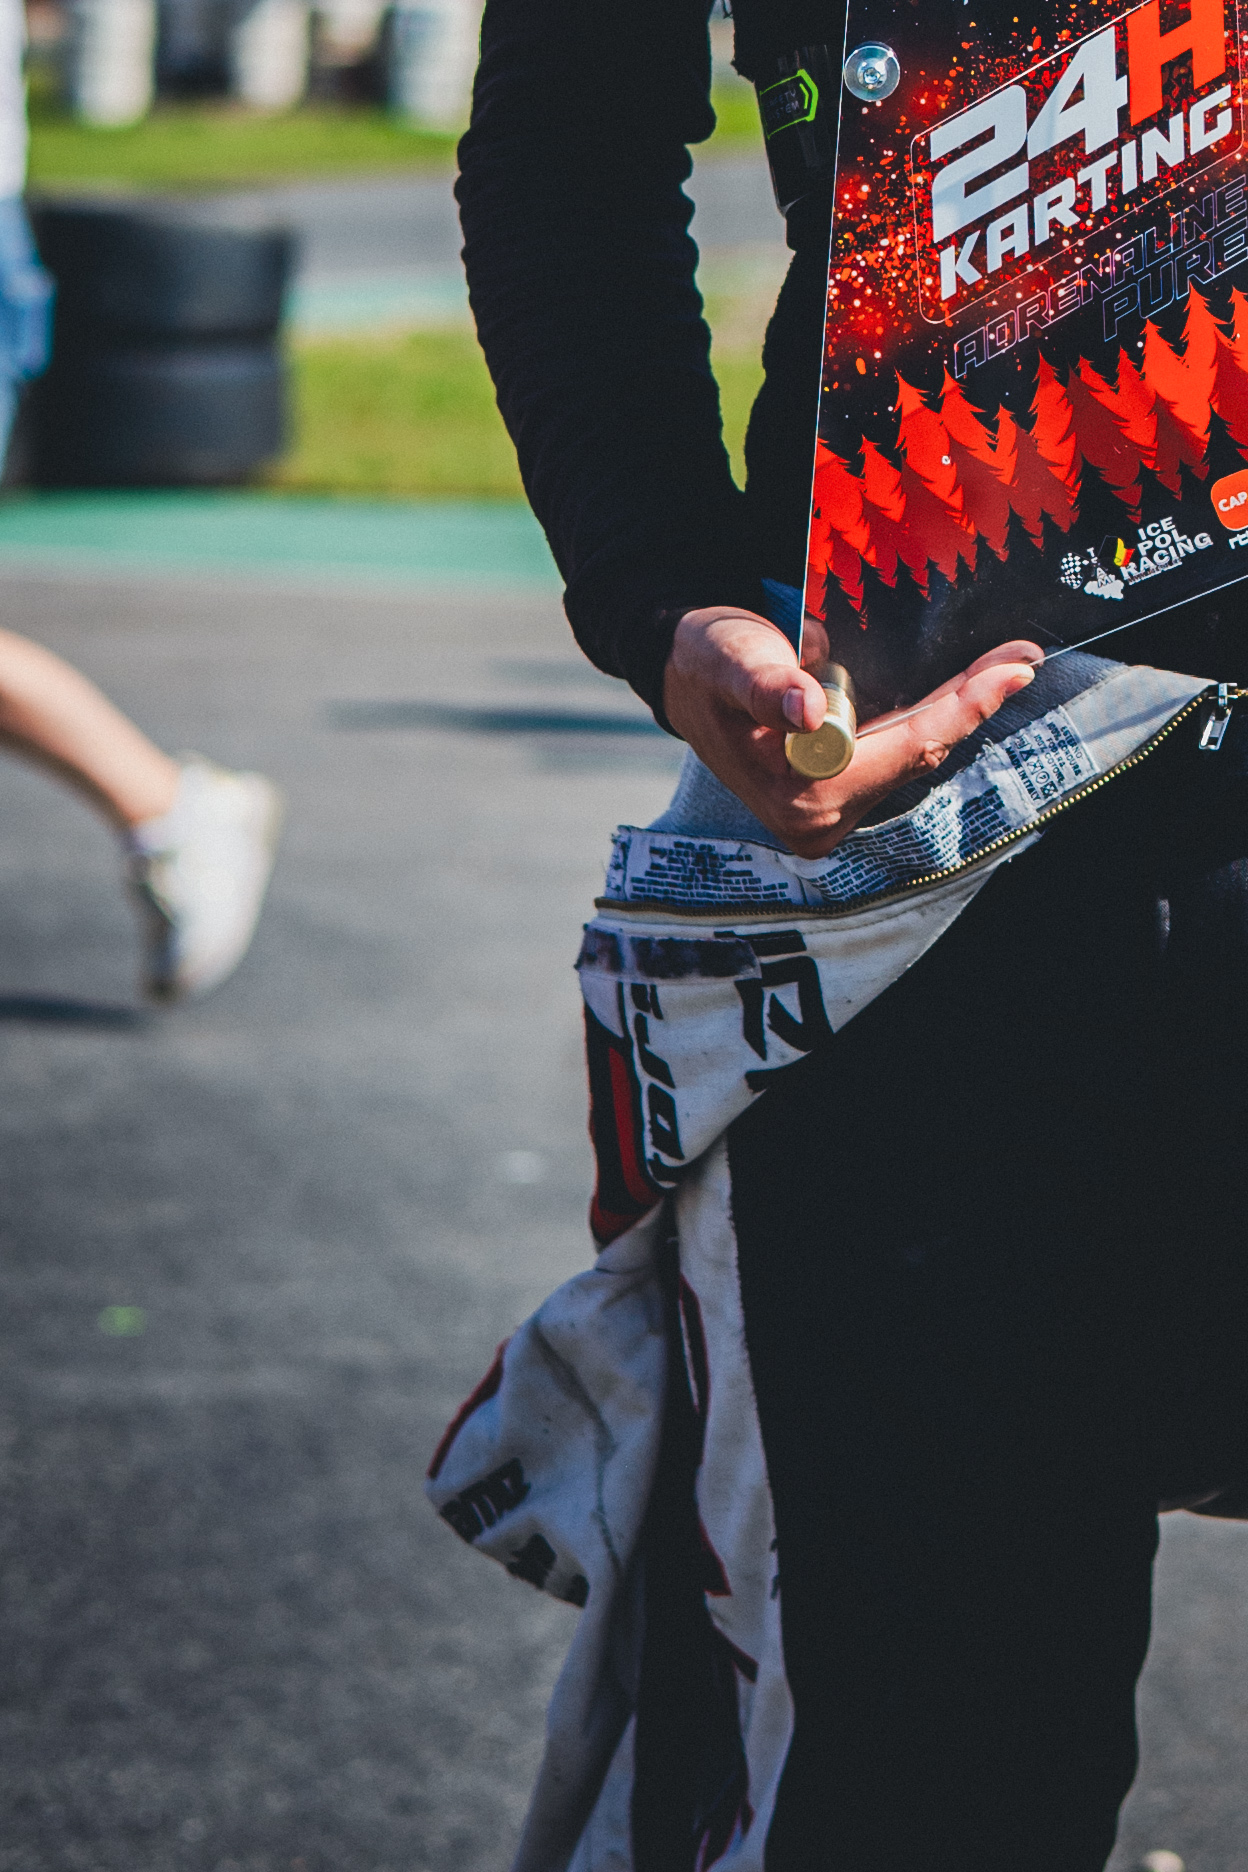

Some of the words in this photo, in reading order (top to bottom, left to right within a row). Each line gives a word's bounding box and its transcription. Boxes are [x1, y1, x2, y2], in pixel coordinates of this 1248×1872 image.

[939, 84, 1233, 301] KARTING
[954, 174, 1248, 379] ADRENALINE
[1137, 529, 1188, 556] POL
[1138, 516, 1176, 541] ICE
[1120, 532, 1214, 581] RACING
